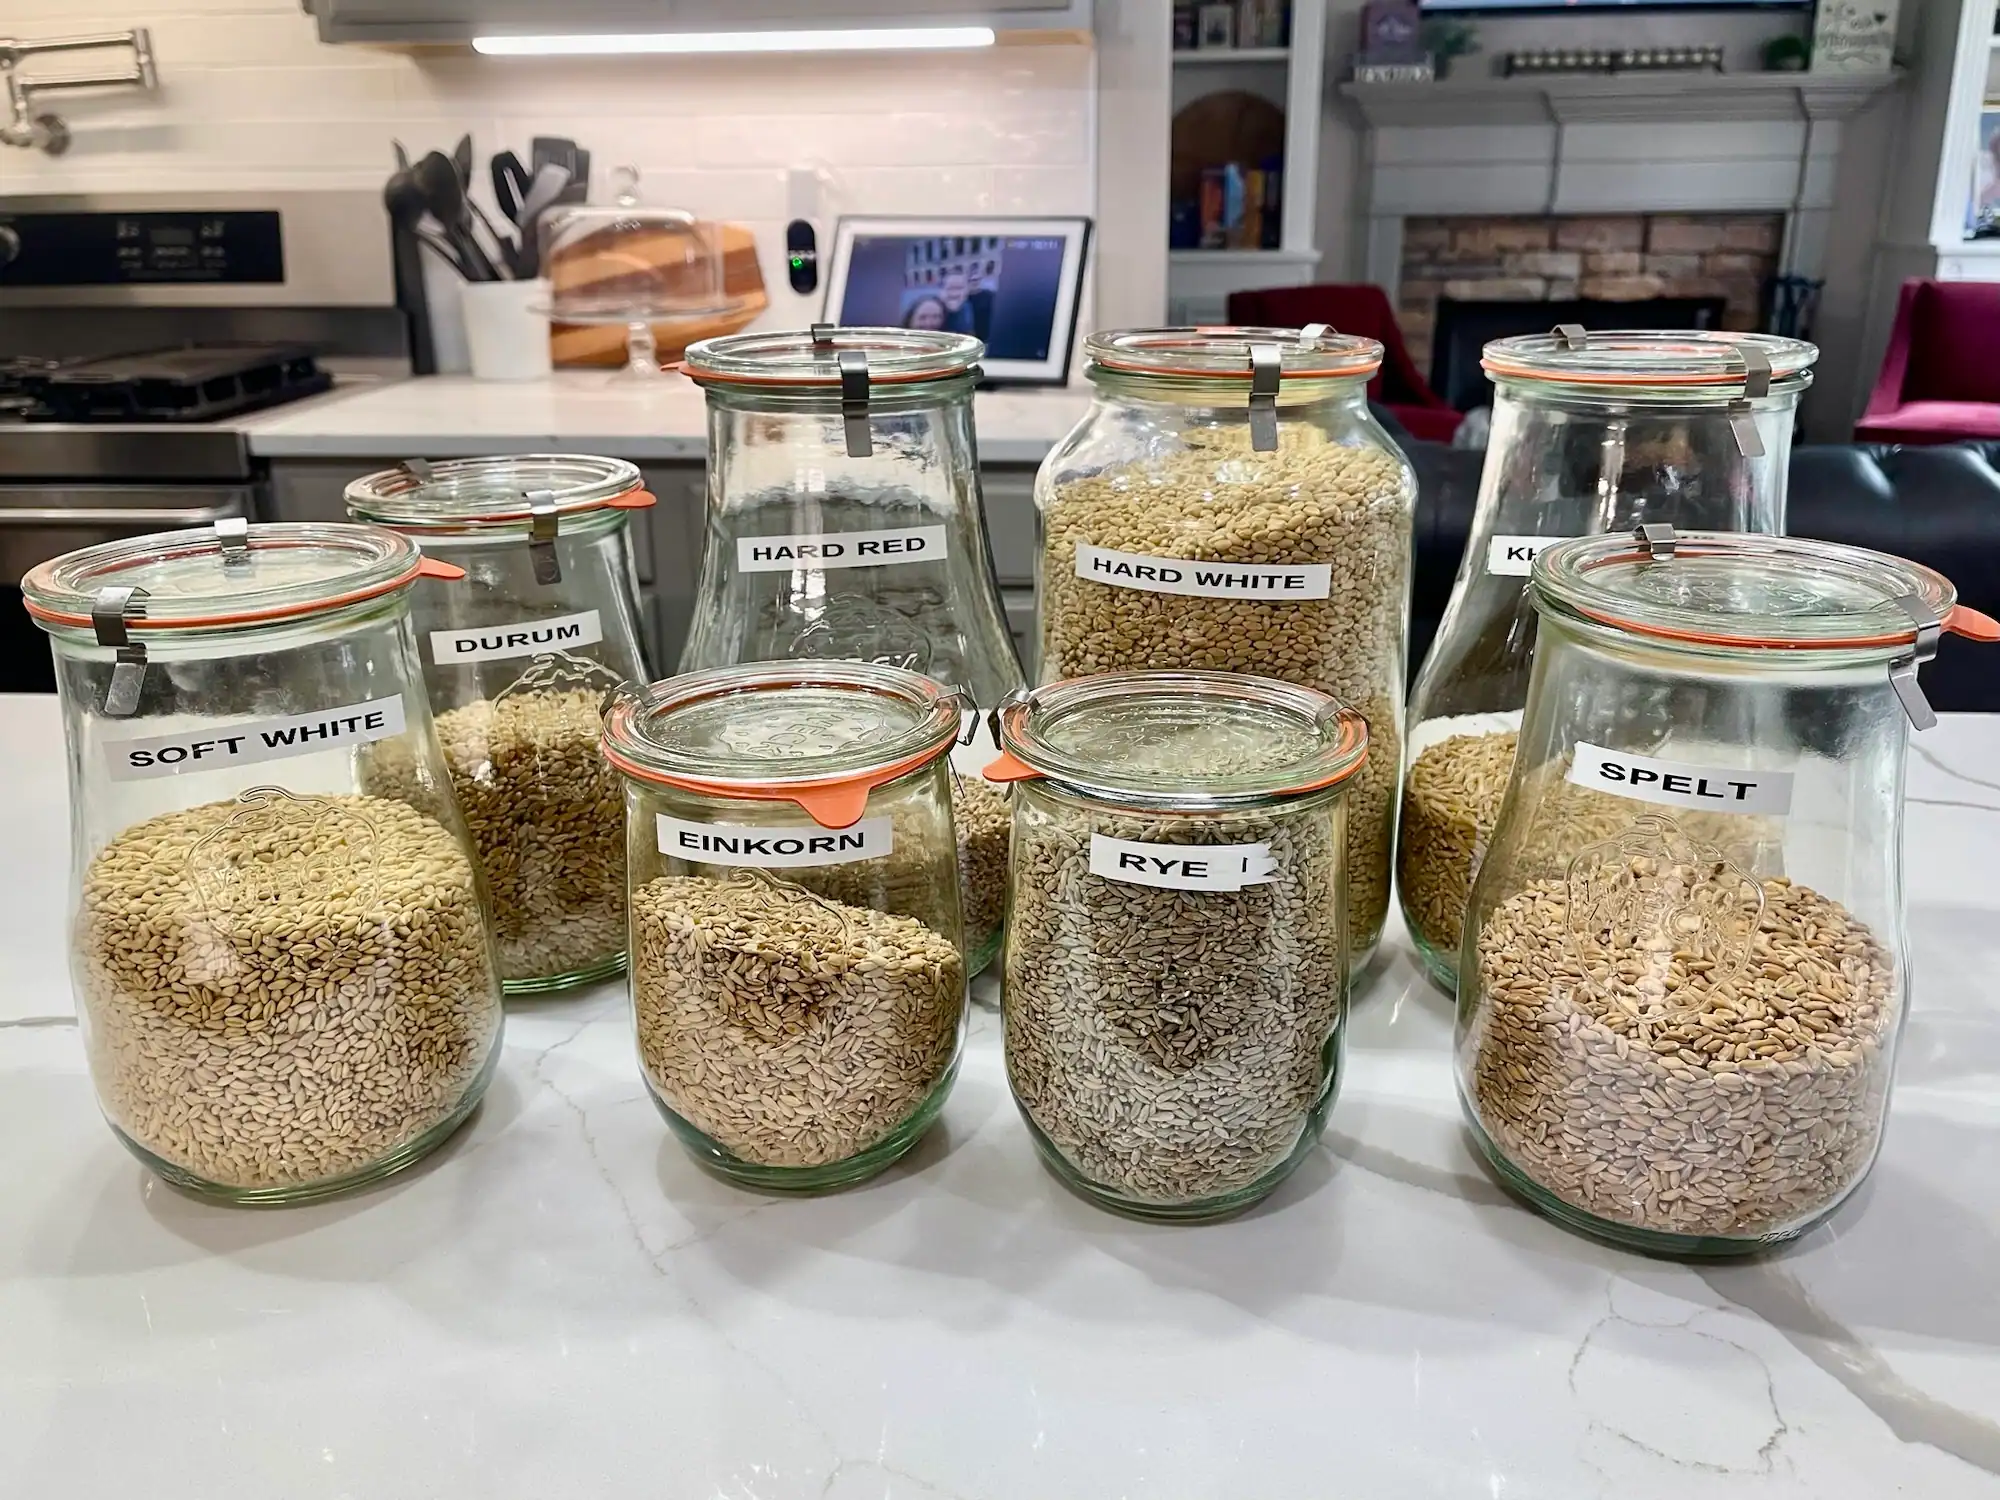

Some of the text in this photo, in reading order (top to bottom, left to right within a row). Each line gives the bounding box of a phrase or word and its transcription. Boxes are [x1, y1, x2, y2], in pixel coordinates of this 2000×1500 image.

[752, 537, 926, 561] HARD RED
[1093, 557, 1306, 590] HARD WHITE
[455, 623, 580, 653] DURUM
[129, 711, 385, 768] SOFT WHITE
[1599, 762, 1758, 801] SPELT
[679, 830, 865, 855] EINKORN
[1119, 852, 1209, 878] RYE
